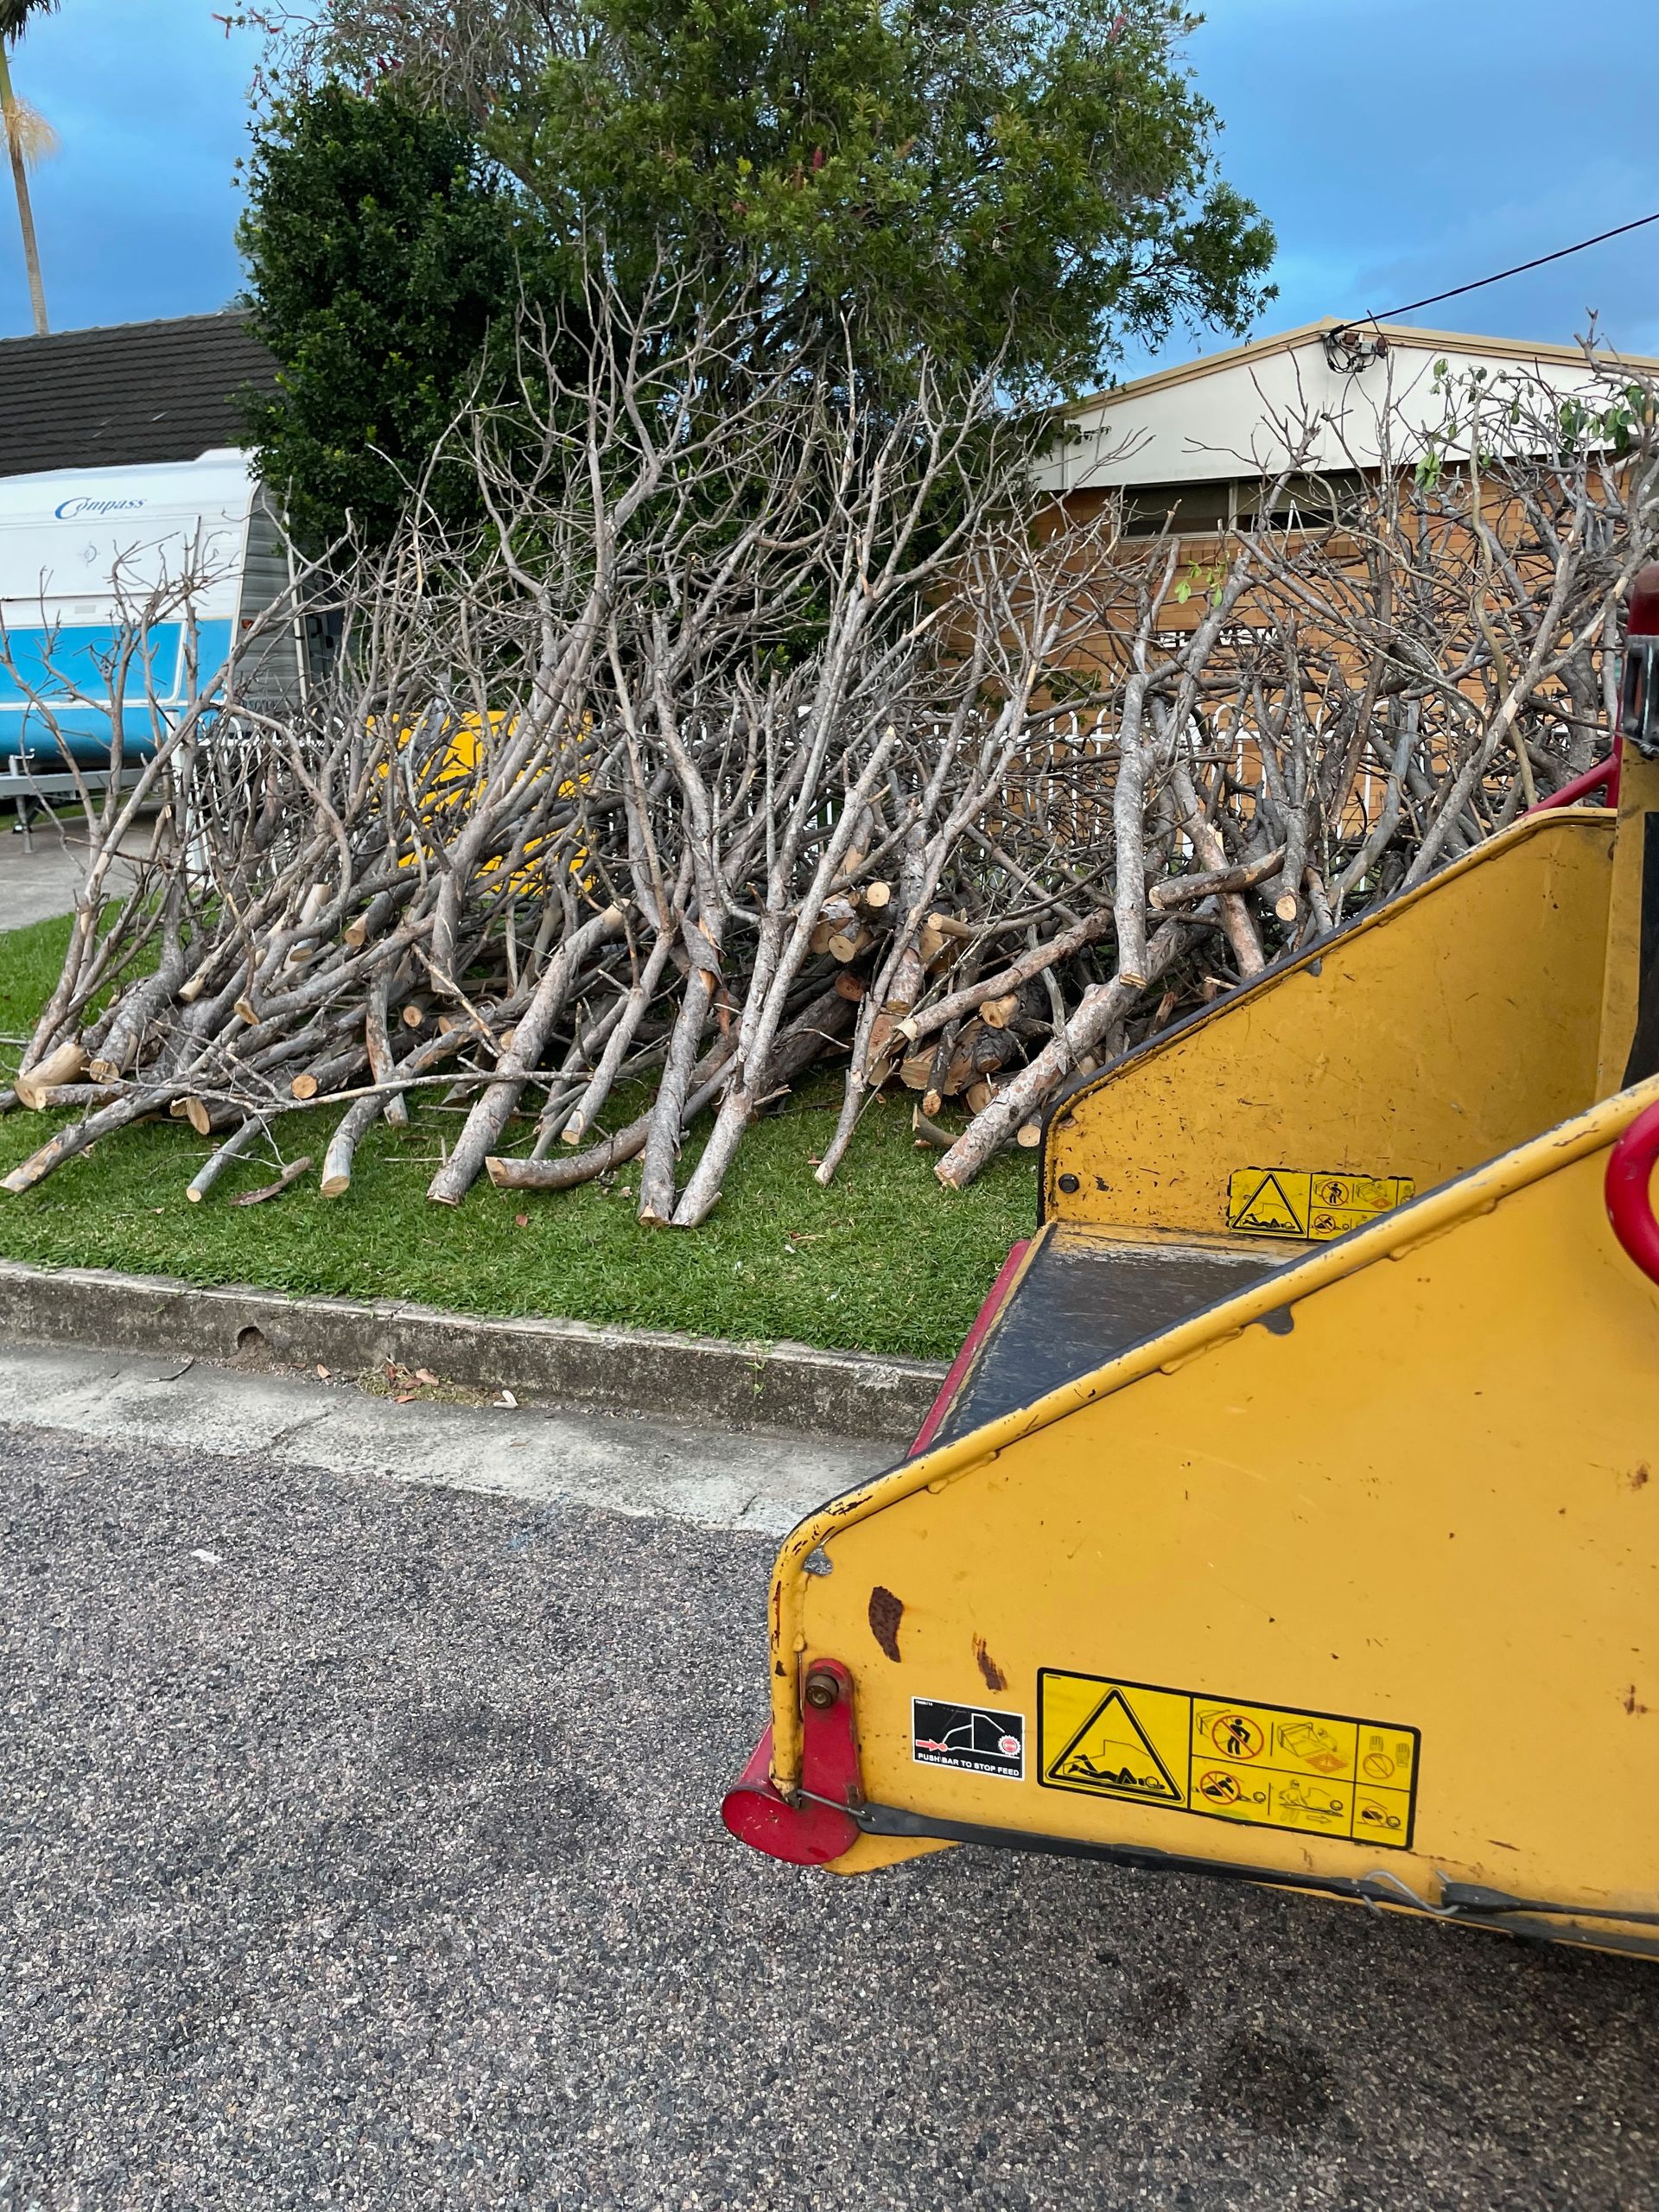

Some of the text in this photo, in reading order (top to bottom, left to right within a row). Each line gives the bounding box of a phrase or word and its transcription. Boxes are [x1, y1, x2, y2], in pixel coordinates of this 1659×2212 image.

[54, 497, 147, 519] Compass
[1160, 628, 1279, 648] ELVEN
[918, 1752, 940, 1763] PUSH
[941, 1757, 959, 1765] BAR
[974, 1763, 995, 1772] STOP
[997, 1767, 1020, 1777] FEED
